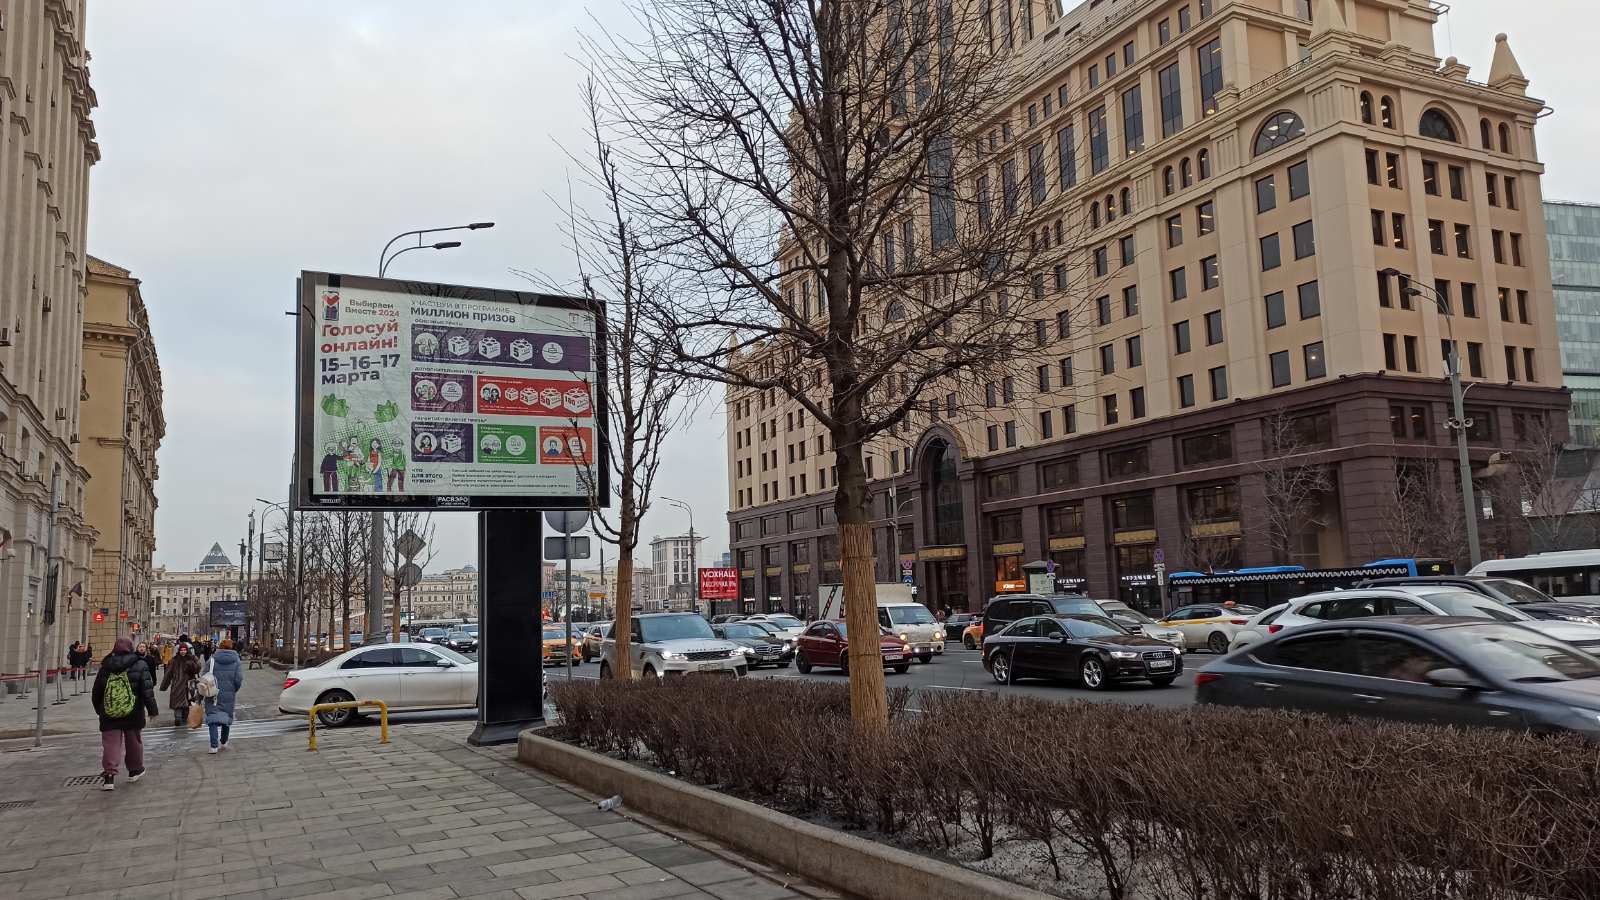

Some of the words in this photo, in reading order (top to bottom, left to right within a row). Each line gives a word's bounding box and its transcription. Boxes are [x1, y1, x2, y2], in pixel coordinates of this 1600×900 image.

[349, 299, 394, 309] Выбираем
[345, 306, 377, 316] Вместе
[378, 308, 400, 317] 2024
[321, 319, 399, 337] Голосуй
[320, 335, 398, 353] онлайн!
[513, 347, 520, 358] 5
[321, 370, 380, 386] марта
[702, 570, 736, 578] VOXHALL
